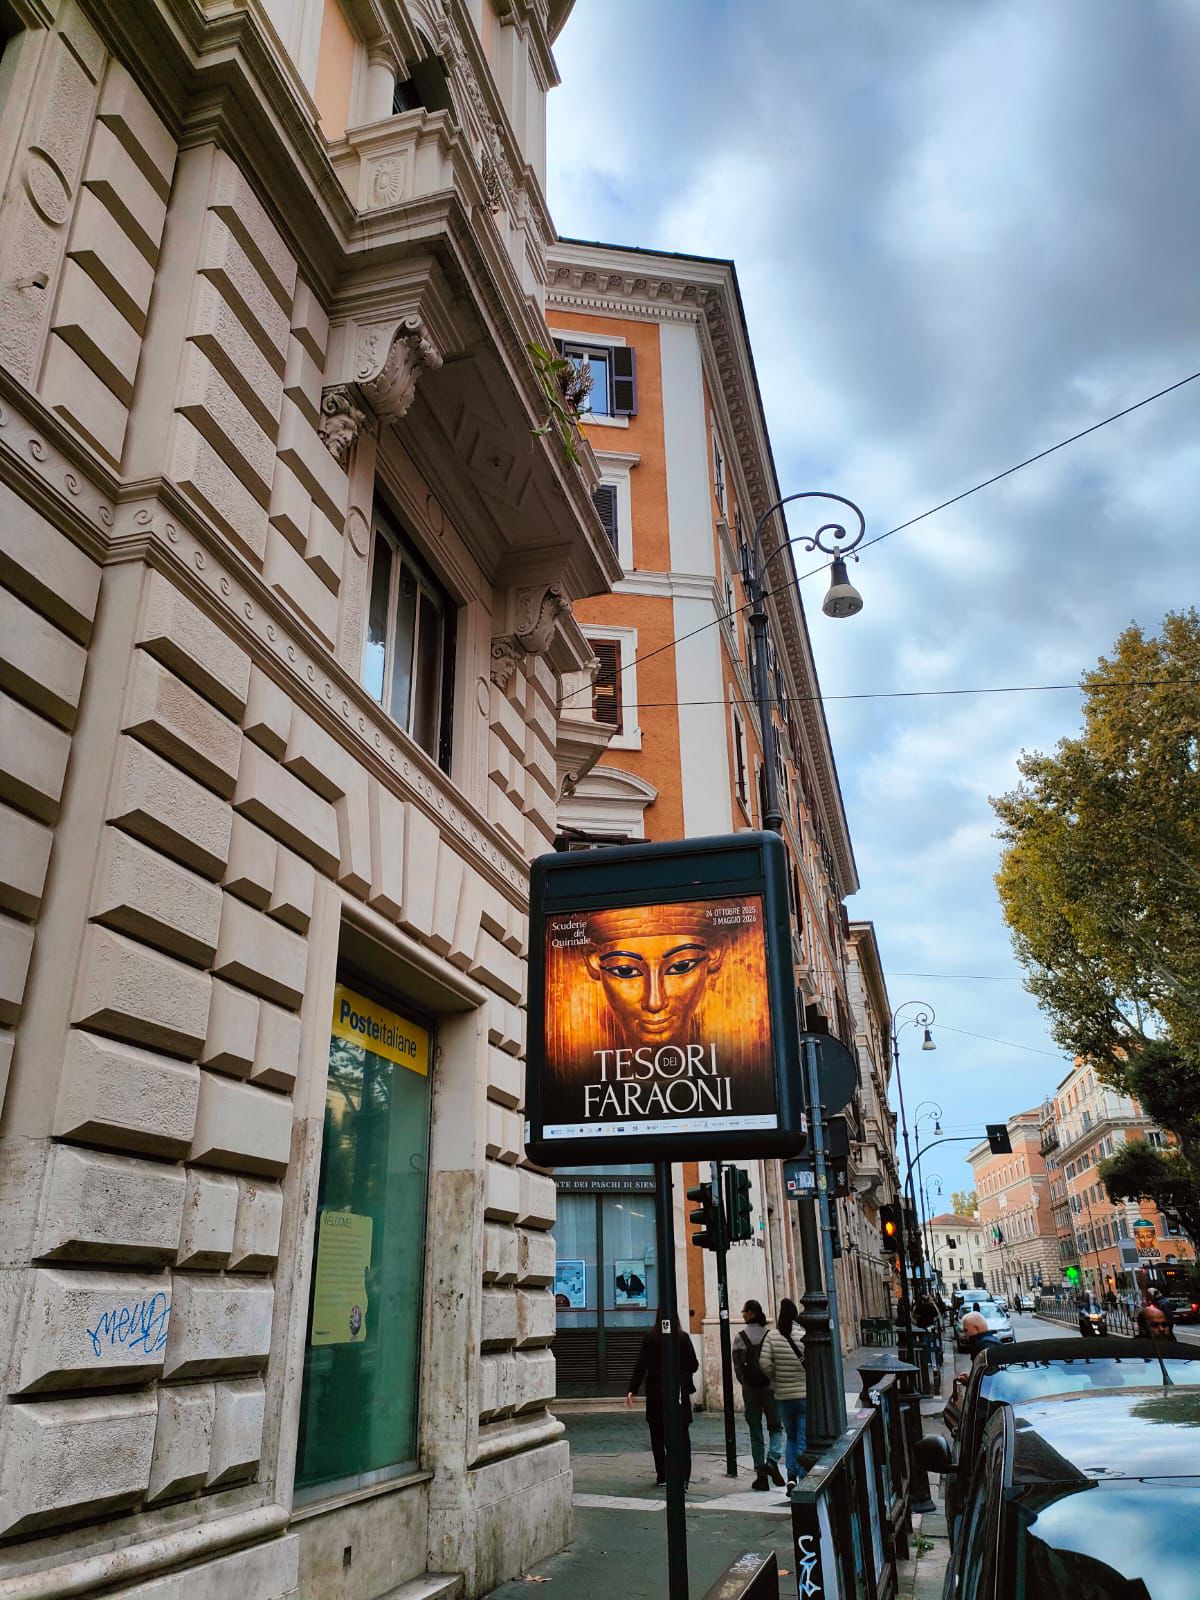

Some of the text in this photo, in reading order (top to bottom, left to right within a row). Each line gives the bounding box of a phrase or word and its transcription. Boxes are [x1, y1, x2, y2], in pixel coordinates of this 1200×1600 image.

[714, 906, 741, 917] OTTOBRE
[741, 905, 756, 915] 2025
[551, 919, 587, 931] Scuderie
[712, 914, 757, 926] 3 MAGGIO 2026
[573, 928, 585, 938] del
[551, 935, 591, 949] Quirinale
[340, 998, 417, 1058] Posteitaliane
[593, 1043, 718, 1082] TESORI
[663, 1056, 678, 1067] DEI
[583, 1076, 734, 1118] FARAONI
[574, 1181, 588, 1189] DEI
[591, 1181, 620, 1189] PASCHI
[623, 1181, 632, 1189] DI
